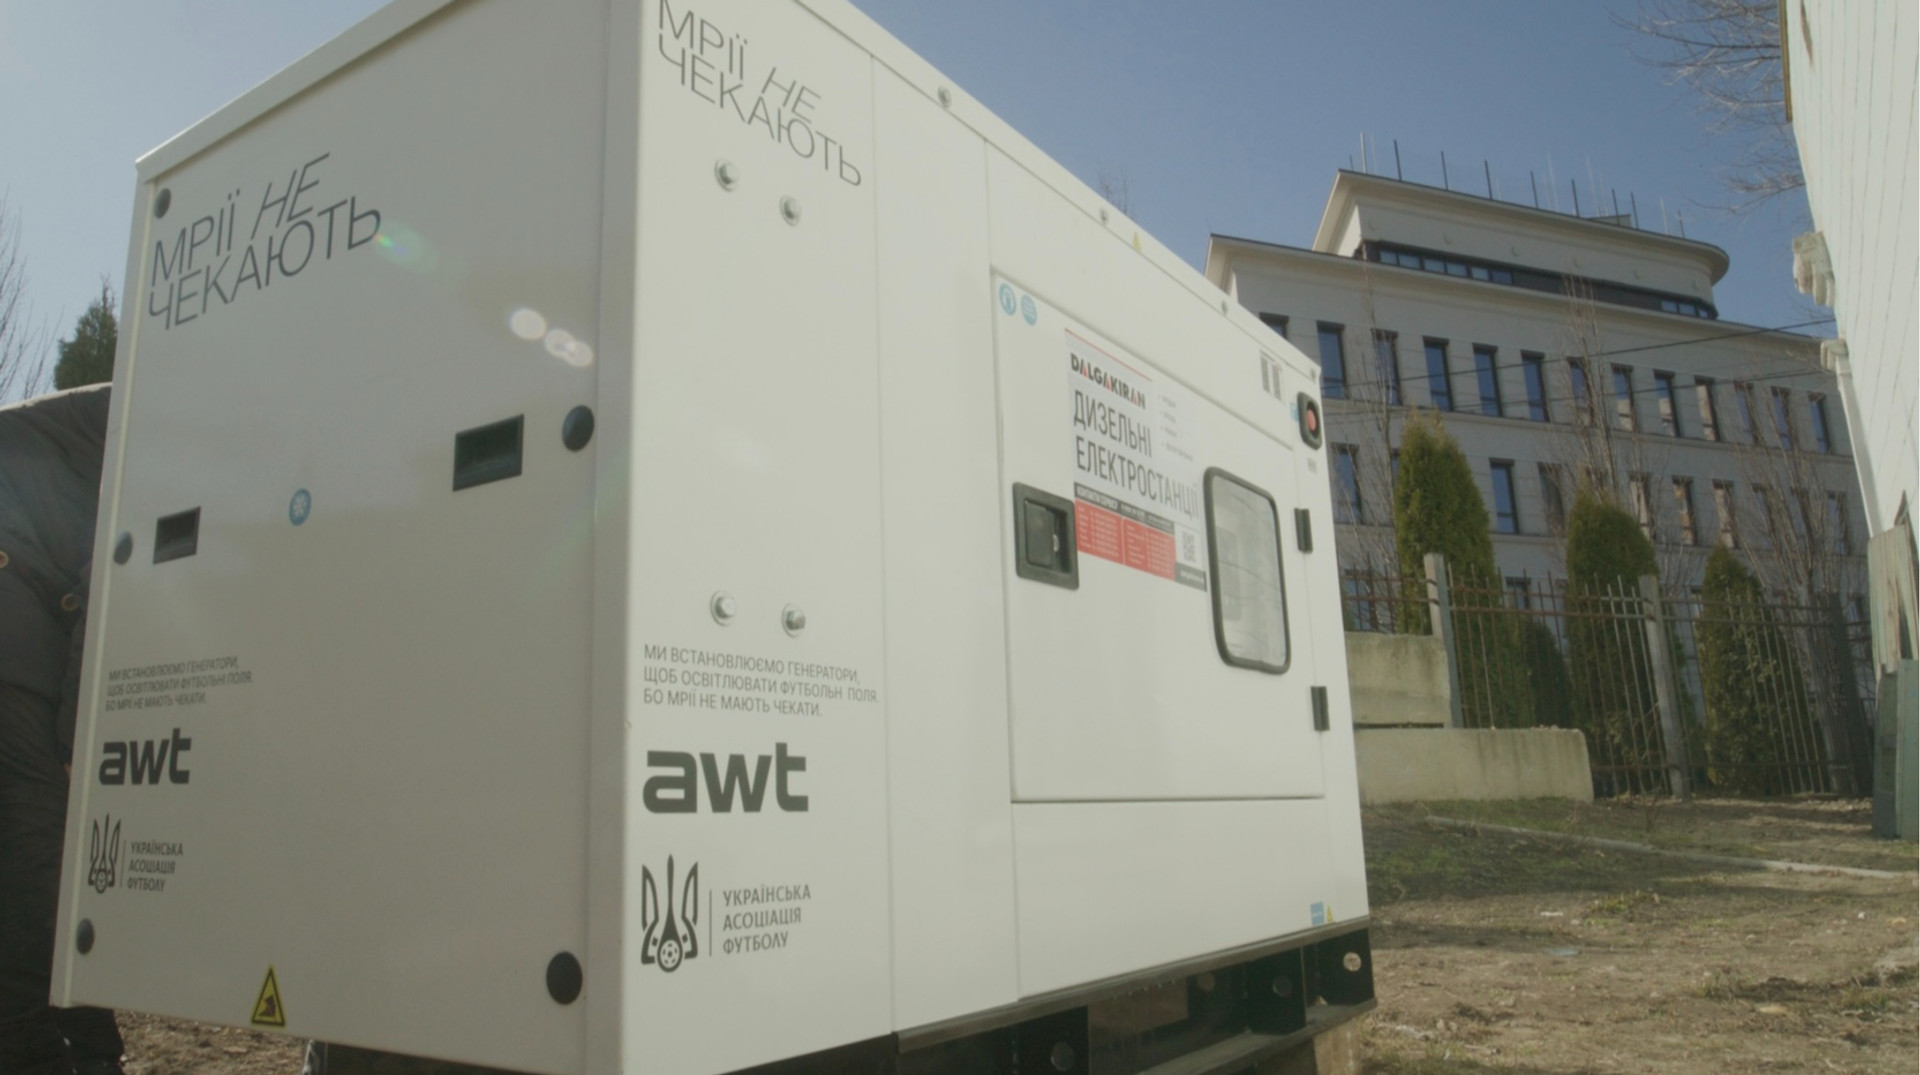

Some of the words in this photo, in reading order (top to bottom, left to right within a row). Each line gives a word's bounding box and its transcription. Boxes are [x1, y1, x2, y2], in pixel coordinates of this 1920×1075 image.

[659, 0, 748, 81] МРІЇ
[761, 66, 821, 124] НЕ
[659, 33, 861, 187] ЧЕКАЮТЬ
[151, 188, 241, 287] МРІЇ
[250, 152, 330, 241] НЕ
[149, 195, 381, 331] ЧЕКАЮТЬ
[1070, 352, 1146, 410] DALGAKIRAN
[1073, 389, 1152, 458] ДИЗЕЛЬНІ
[1076, 434, 1199, 521] ЕЛЕКТРОСТАНЦІЇ
[643, 666, 678, 685] ЩОБ
[681, 670, 777, 694] ОСВІТЛЮВАТИ
[644, 644, 667, 661] МИ
[671, 647, 785, 675] ВСТАНОВЛЮЄМО
[788, 661, 860, 685] ГЕНЕРАТОРИ,
[643, 688, 664, 705] БО
[668, 689, 696, 708] МРІЇ
[699, 692, 717, 709] НЕ
[721, 695, 770, 713] МАЮТЬ
[774, 701, 823, 717] ЧЕКАТИ.
[98, 727, 192, 785] awt
[643, 742, 809, 814] awt
[127, 877, 166, 892] ФУТБОЛУ
[722, 884, 811, 907] УКРАЇНСЬКА
[722, 907, 802, 931] АСОЦІАЦІЯ
[722, 931, 789, 955] ФУТБОЛУ
